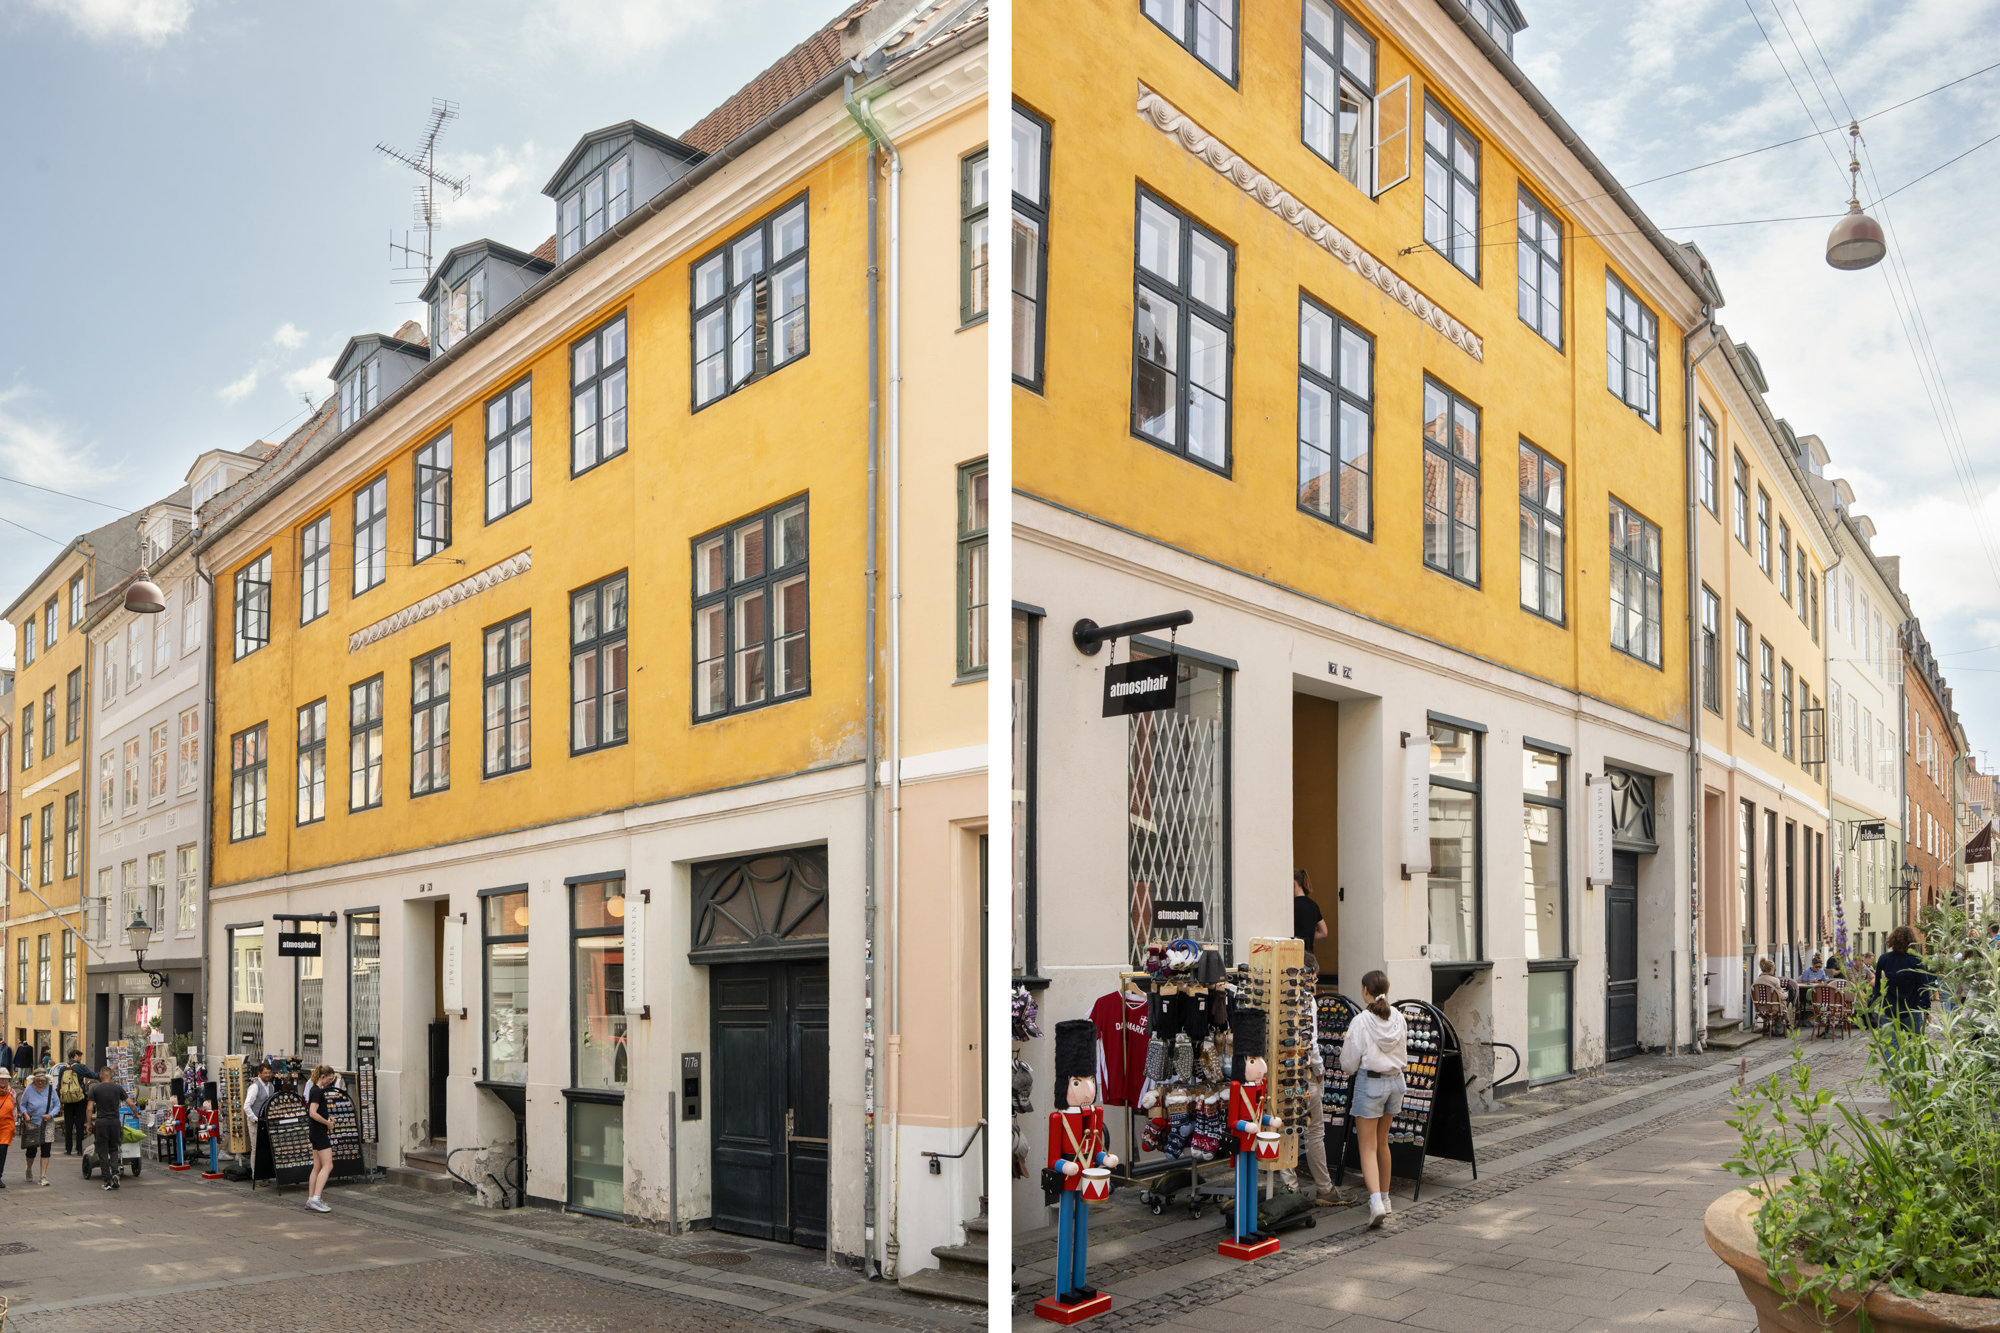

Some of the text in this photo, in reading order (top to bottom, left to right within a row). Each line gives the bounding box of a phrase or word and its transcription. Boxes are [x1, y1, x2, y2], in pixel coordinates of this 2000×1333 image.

[1110, 674, 1168, 698] atmosphair
[1861, 832, 1884, 841] Fontaine
[1157, 909, 1199, 921] atmosphair
[282, 940, 317, 949] atmosphair
[684, 1056, 699, 1068] 7/7a
